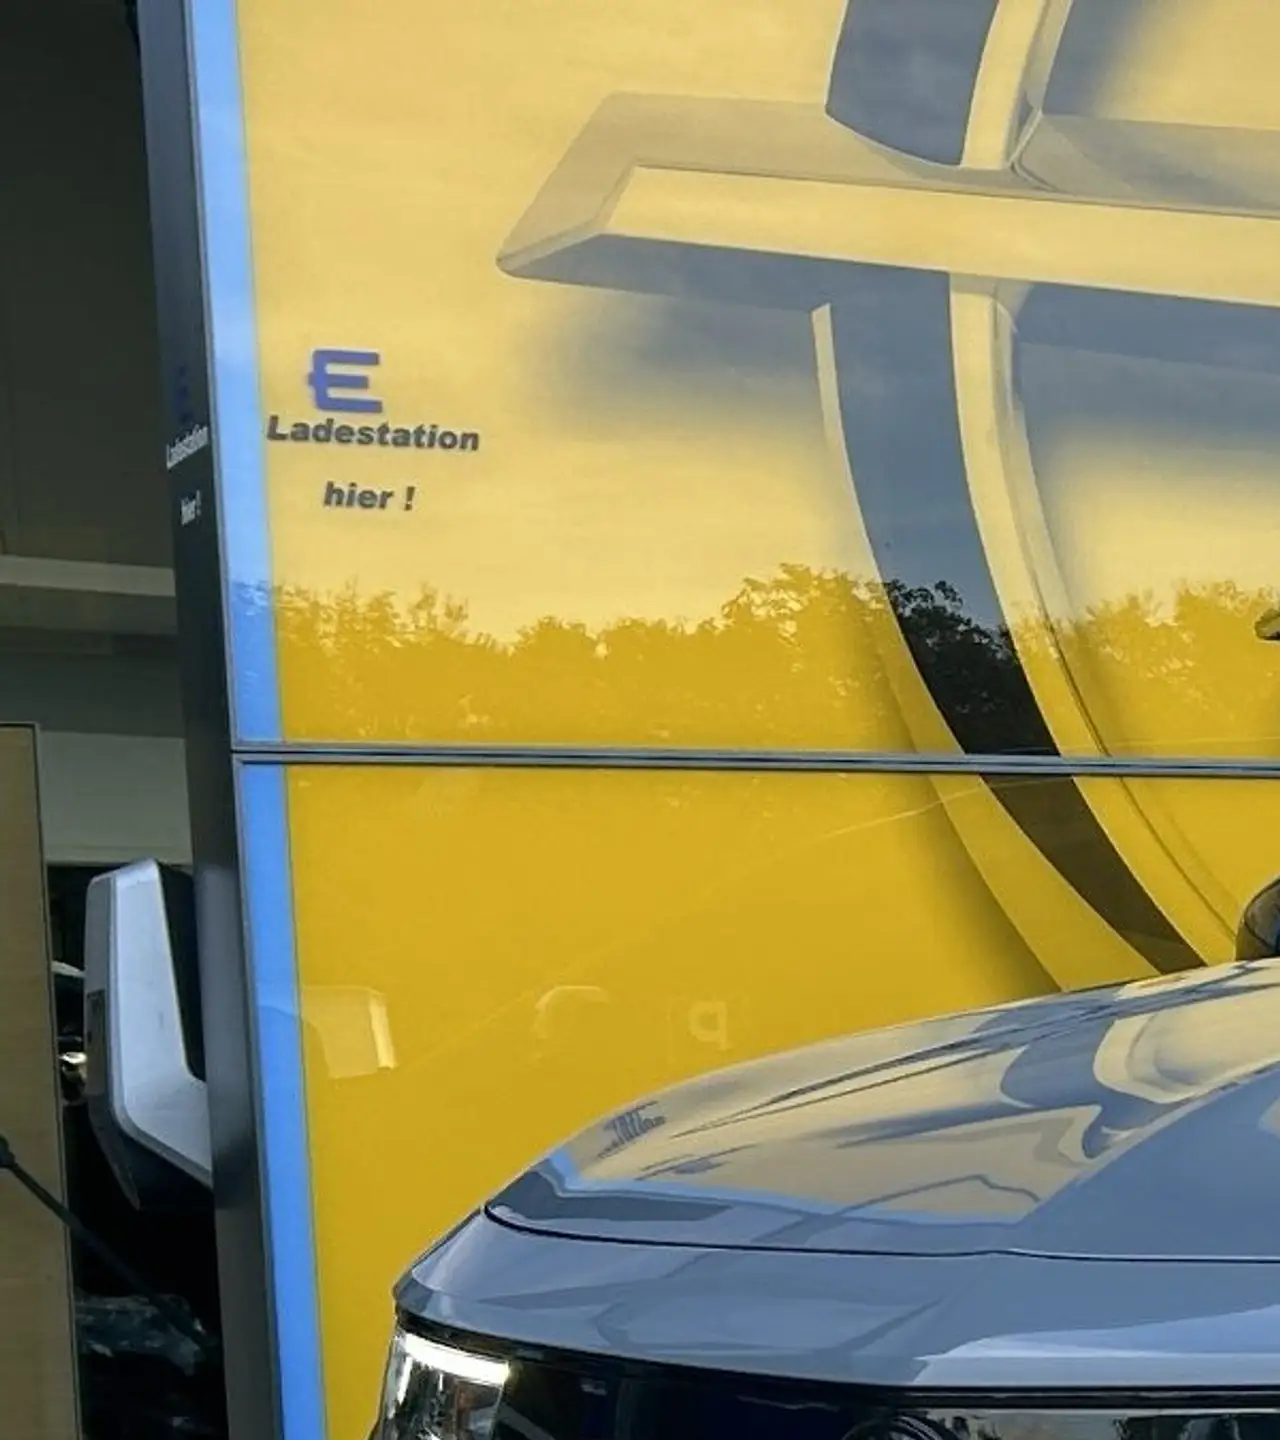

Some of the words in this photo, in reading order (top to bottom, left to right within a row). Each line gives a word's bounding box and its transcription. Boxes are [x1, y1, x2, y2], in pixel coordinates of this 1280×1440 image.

[267, 415, 479, 452] Ladestation
[324, 481, 394, 510] hier
[405, 486, 416, 511] !
